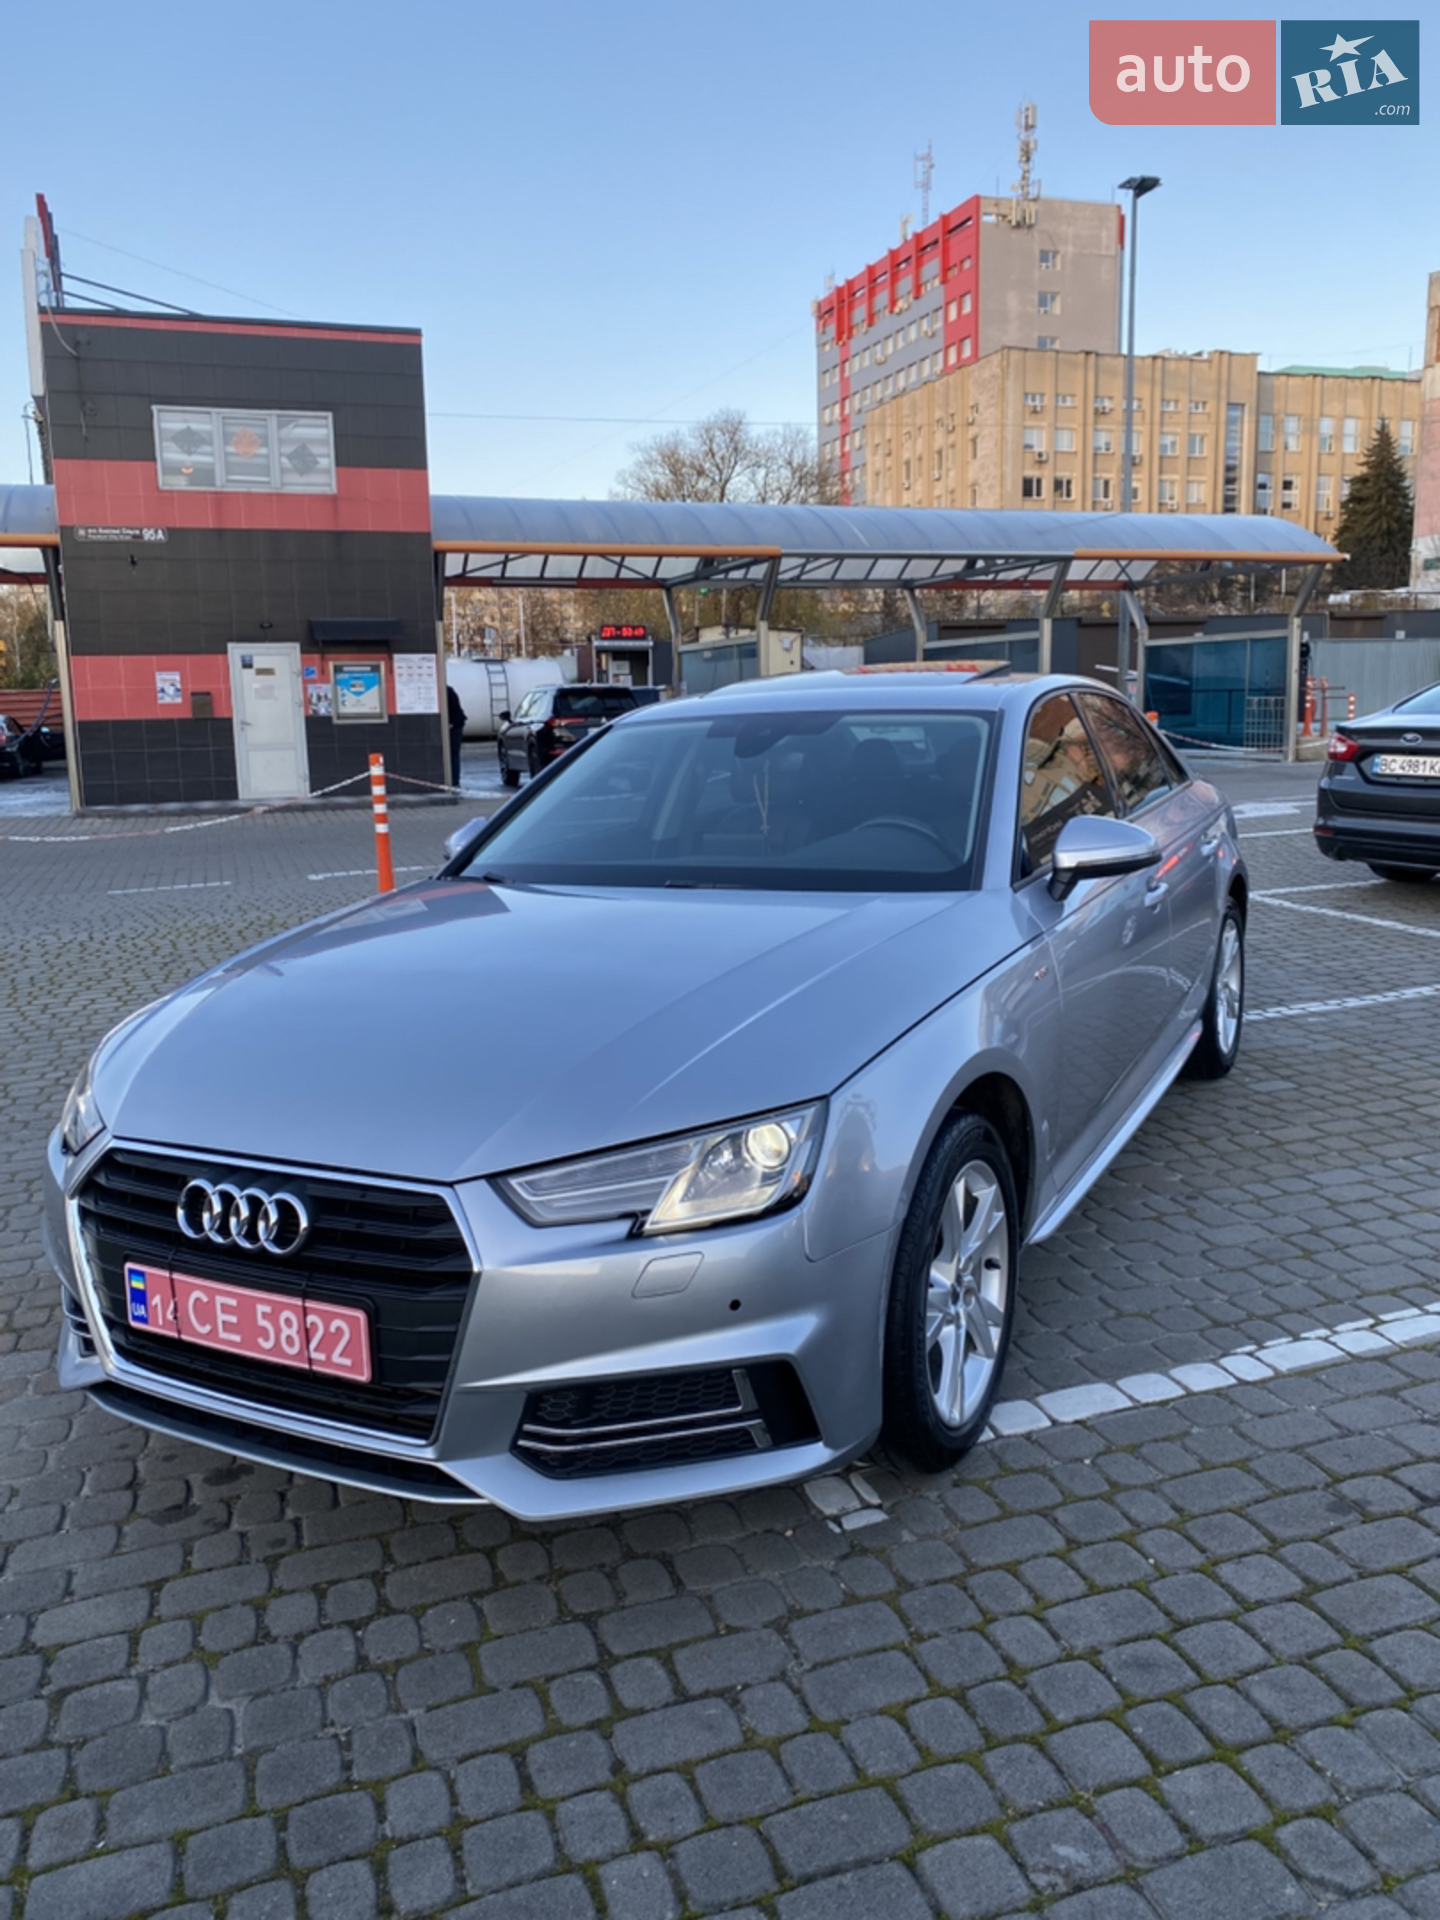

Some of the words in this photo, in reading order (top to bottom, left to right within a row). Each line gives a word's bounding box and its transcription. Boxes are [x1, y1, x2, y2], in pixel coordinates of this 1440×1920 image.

[1379, 757, 1398, 773] BC
[1428, 759, 1440, 775] K
[131, 1302, 147, 1318] UA
[188, 1289, 242, 1343] CE
[255, 1303, 353, 1367] 5822
